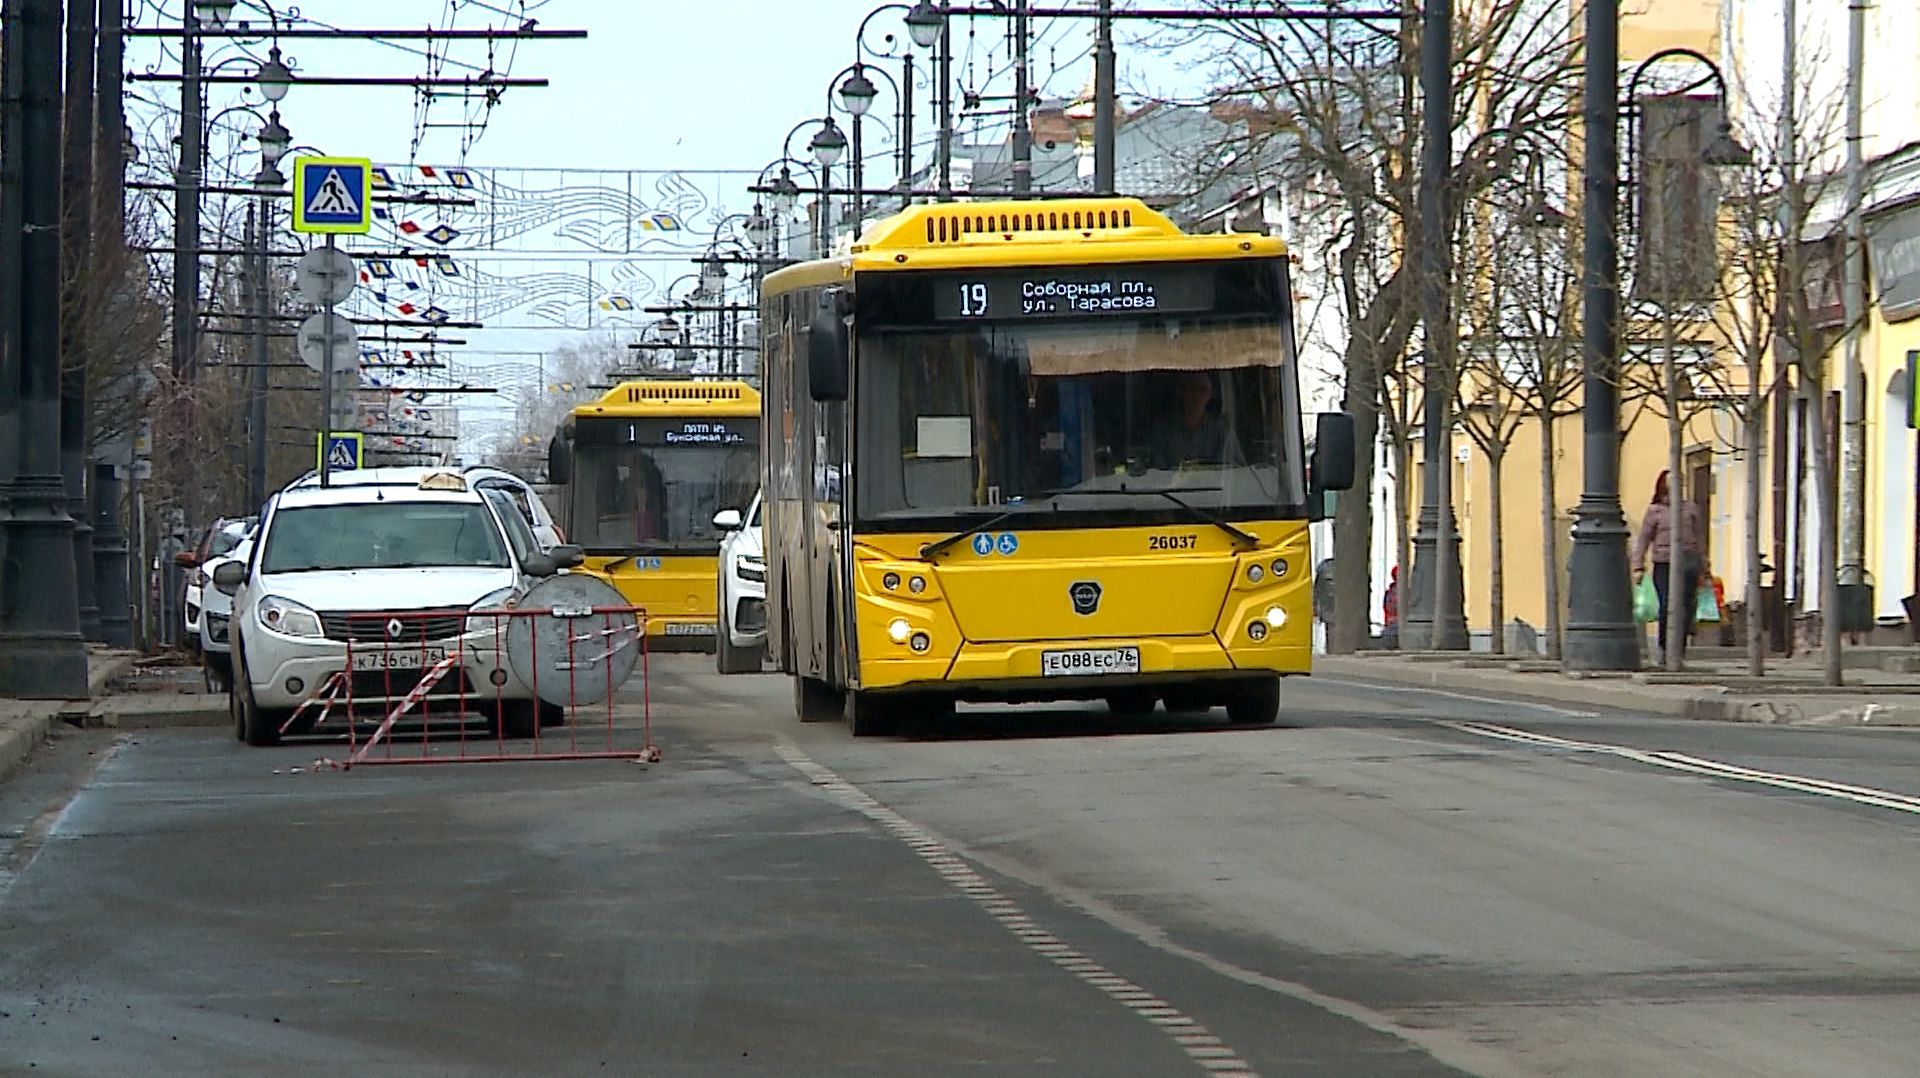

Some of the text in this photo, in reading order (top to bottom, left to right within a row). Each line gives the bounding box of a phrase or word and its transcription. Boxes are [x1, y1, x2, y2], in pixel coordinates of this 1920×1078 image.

[1022, 281, 1155, 298] Соборная пл.
[960, 284, 988, 316] 19
[1023, 295, 1156, 313] ул. Тарасова
[629, 424, 635, 441] 1
[683, 424, 709, 433] ПАТП
[1148, 534, 1198, 550] 26037
[1117, 650, 1133, 662] 76
